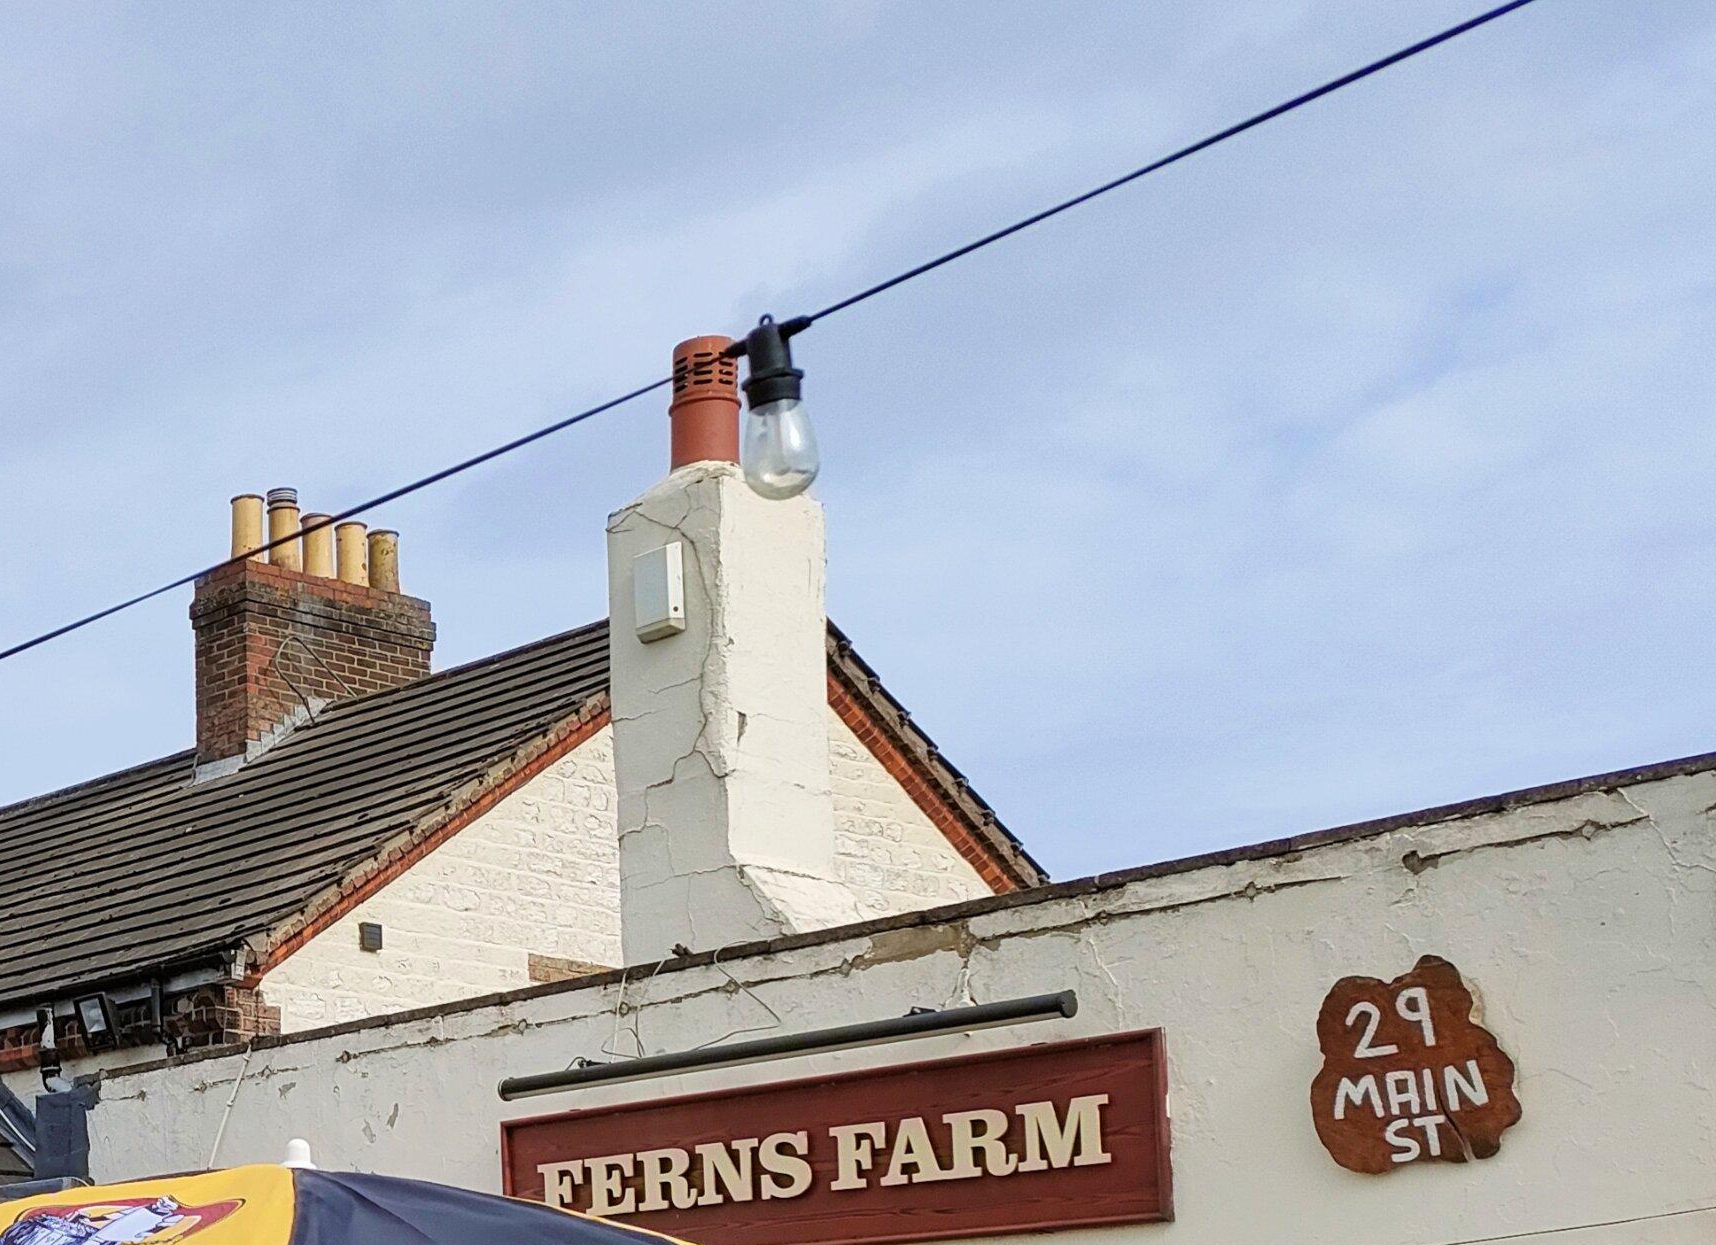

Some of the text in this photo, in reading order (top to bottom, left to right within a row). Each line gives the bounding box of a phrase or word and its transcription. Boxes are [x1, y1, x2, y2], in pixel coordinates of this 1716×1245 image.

[1345, 986, 1436, 1058] 29
[1334, 1060, 1489, 1120] MAIN
[537, 1093, 1113, 1217] FERNS FARM
[1385, 1115, 1445, 1163] ST
